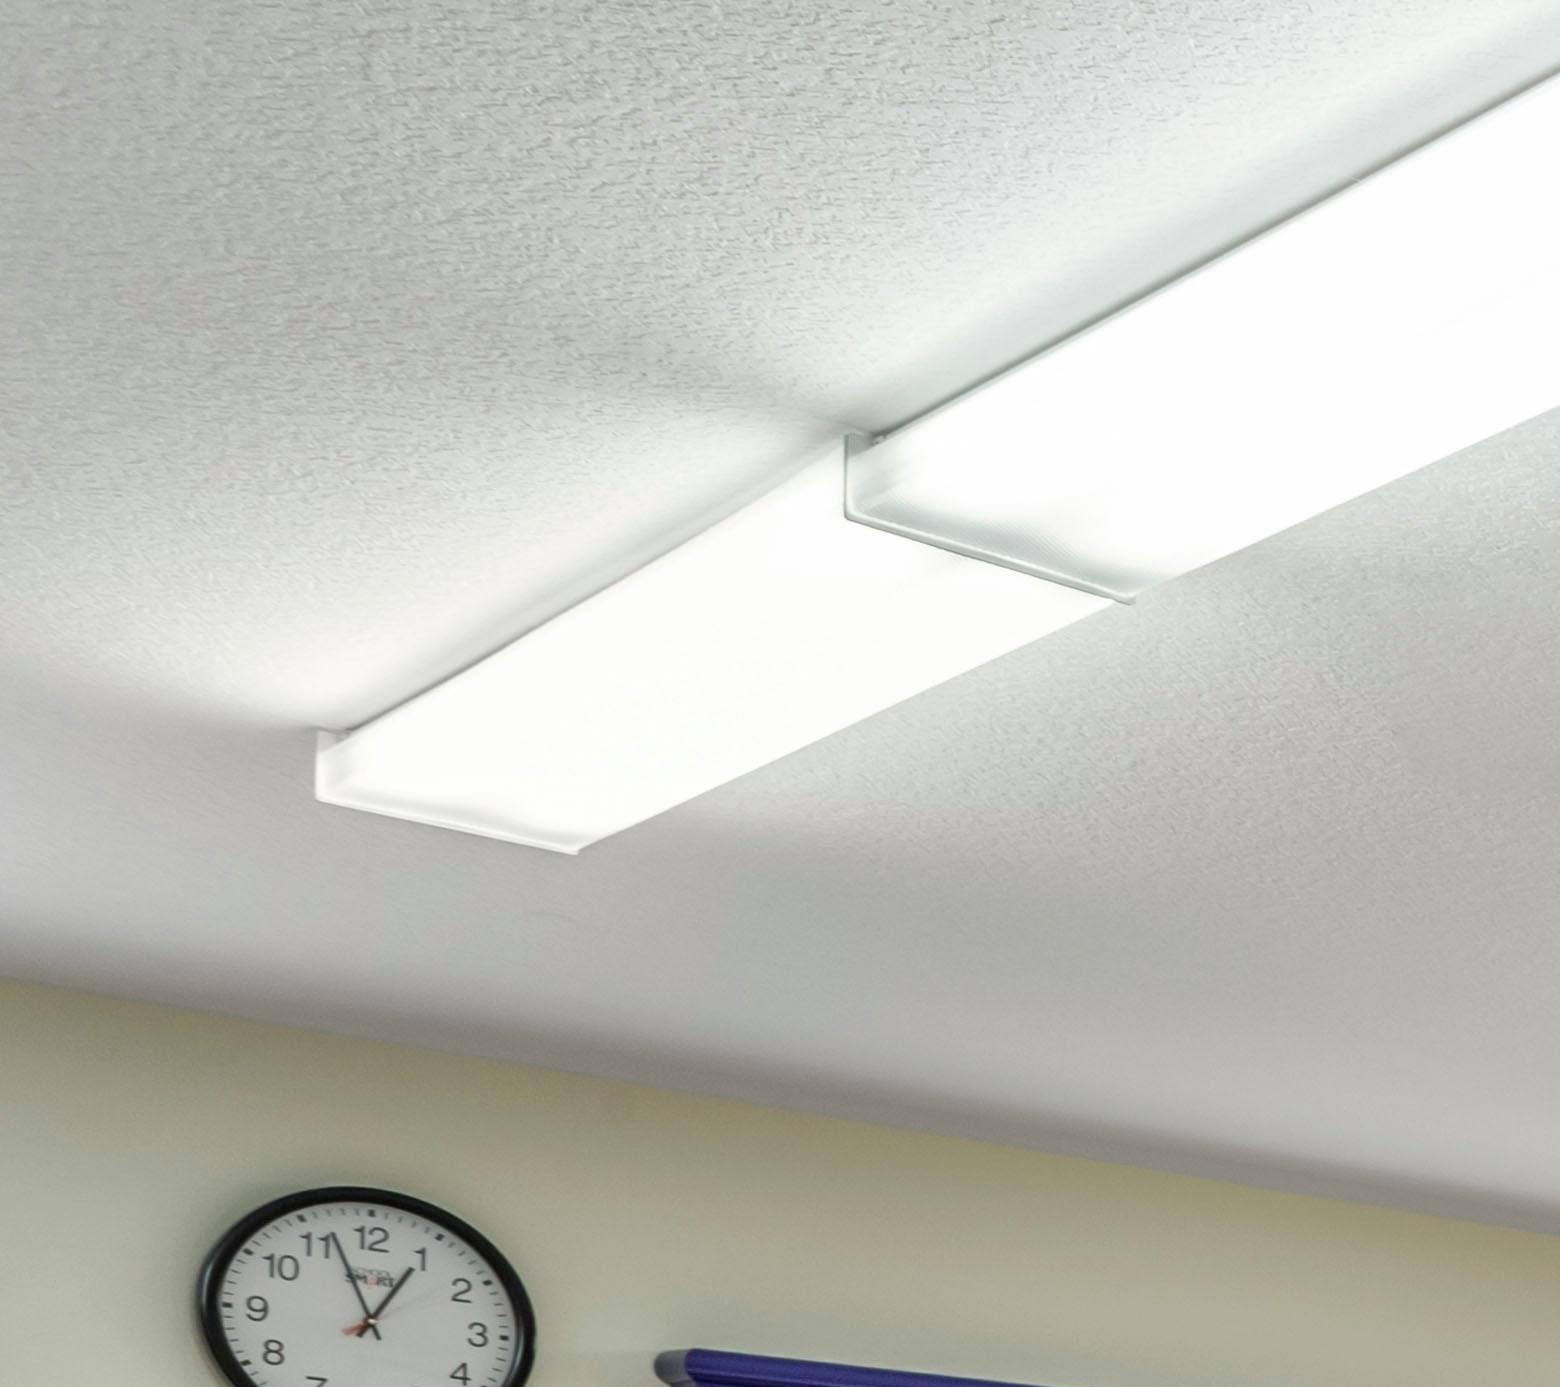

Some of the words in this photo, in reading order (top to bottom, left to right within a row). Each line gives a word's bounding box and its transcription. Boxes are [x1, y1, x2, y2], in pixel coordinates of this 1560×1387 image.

[354, 1227, 391, 1253] 12
[263, 1255, 300, 1281] 10
[413, 1248, 429, 1271] 1
[451, 1279, 472, 1303] 2
[246, 1296, 268, 1321] 9
[467, 1322, 488, 1347] 3
[262, 1340, 285, 1365] 8
[450, 1363, 471, 1386] 4
